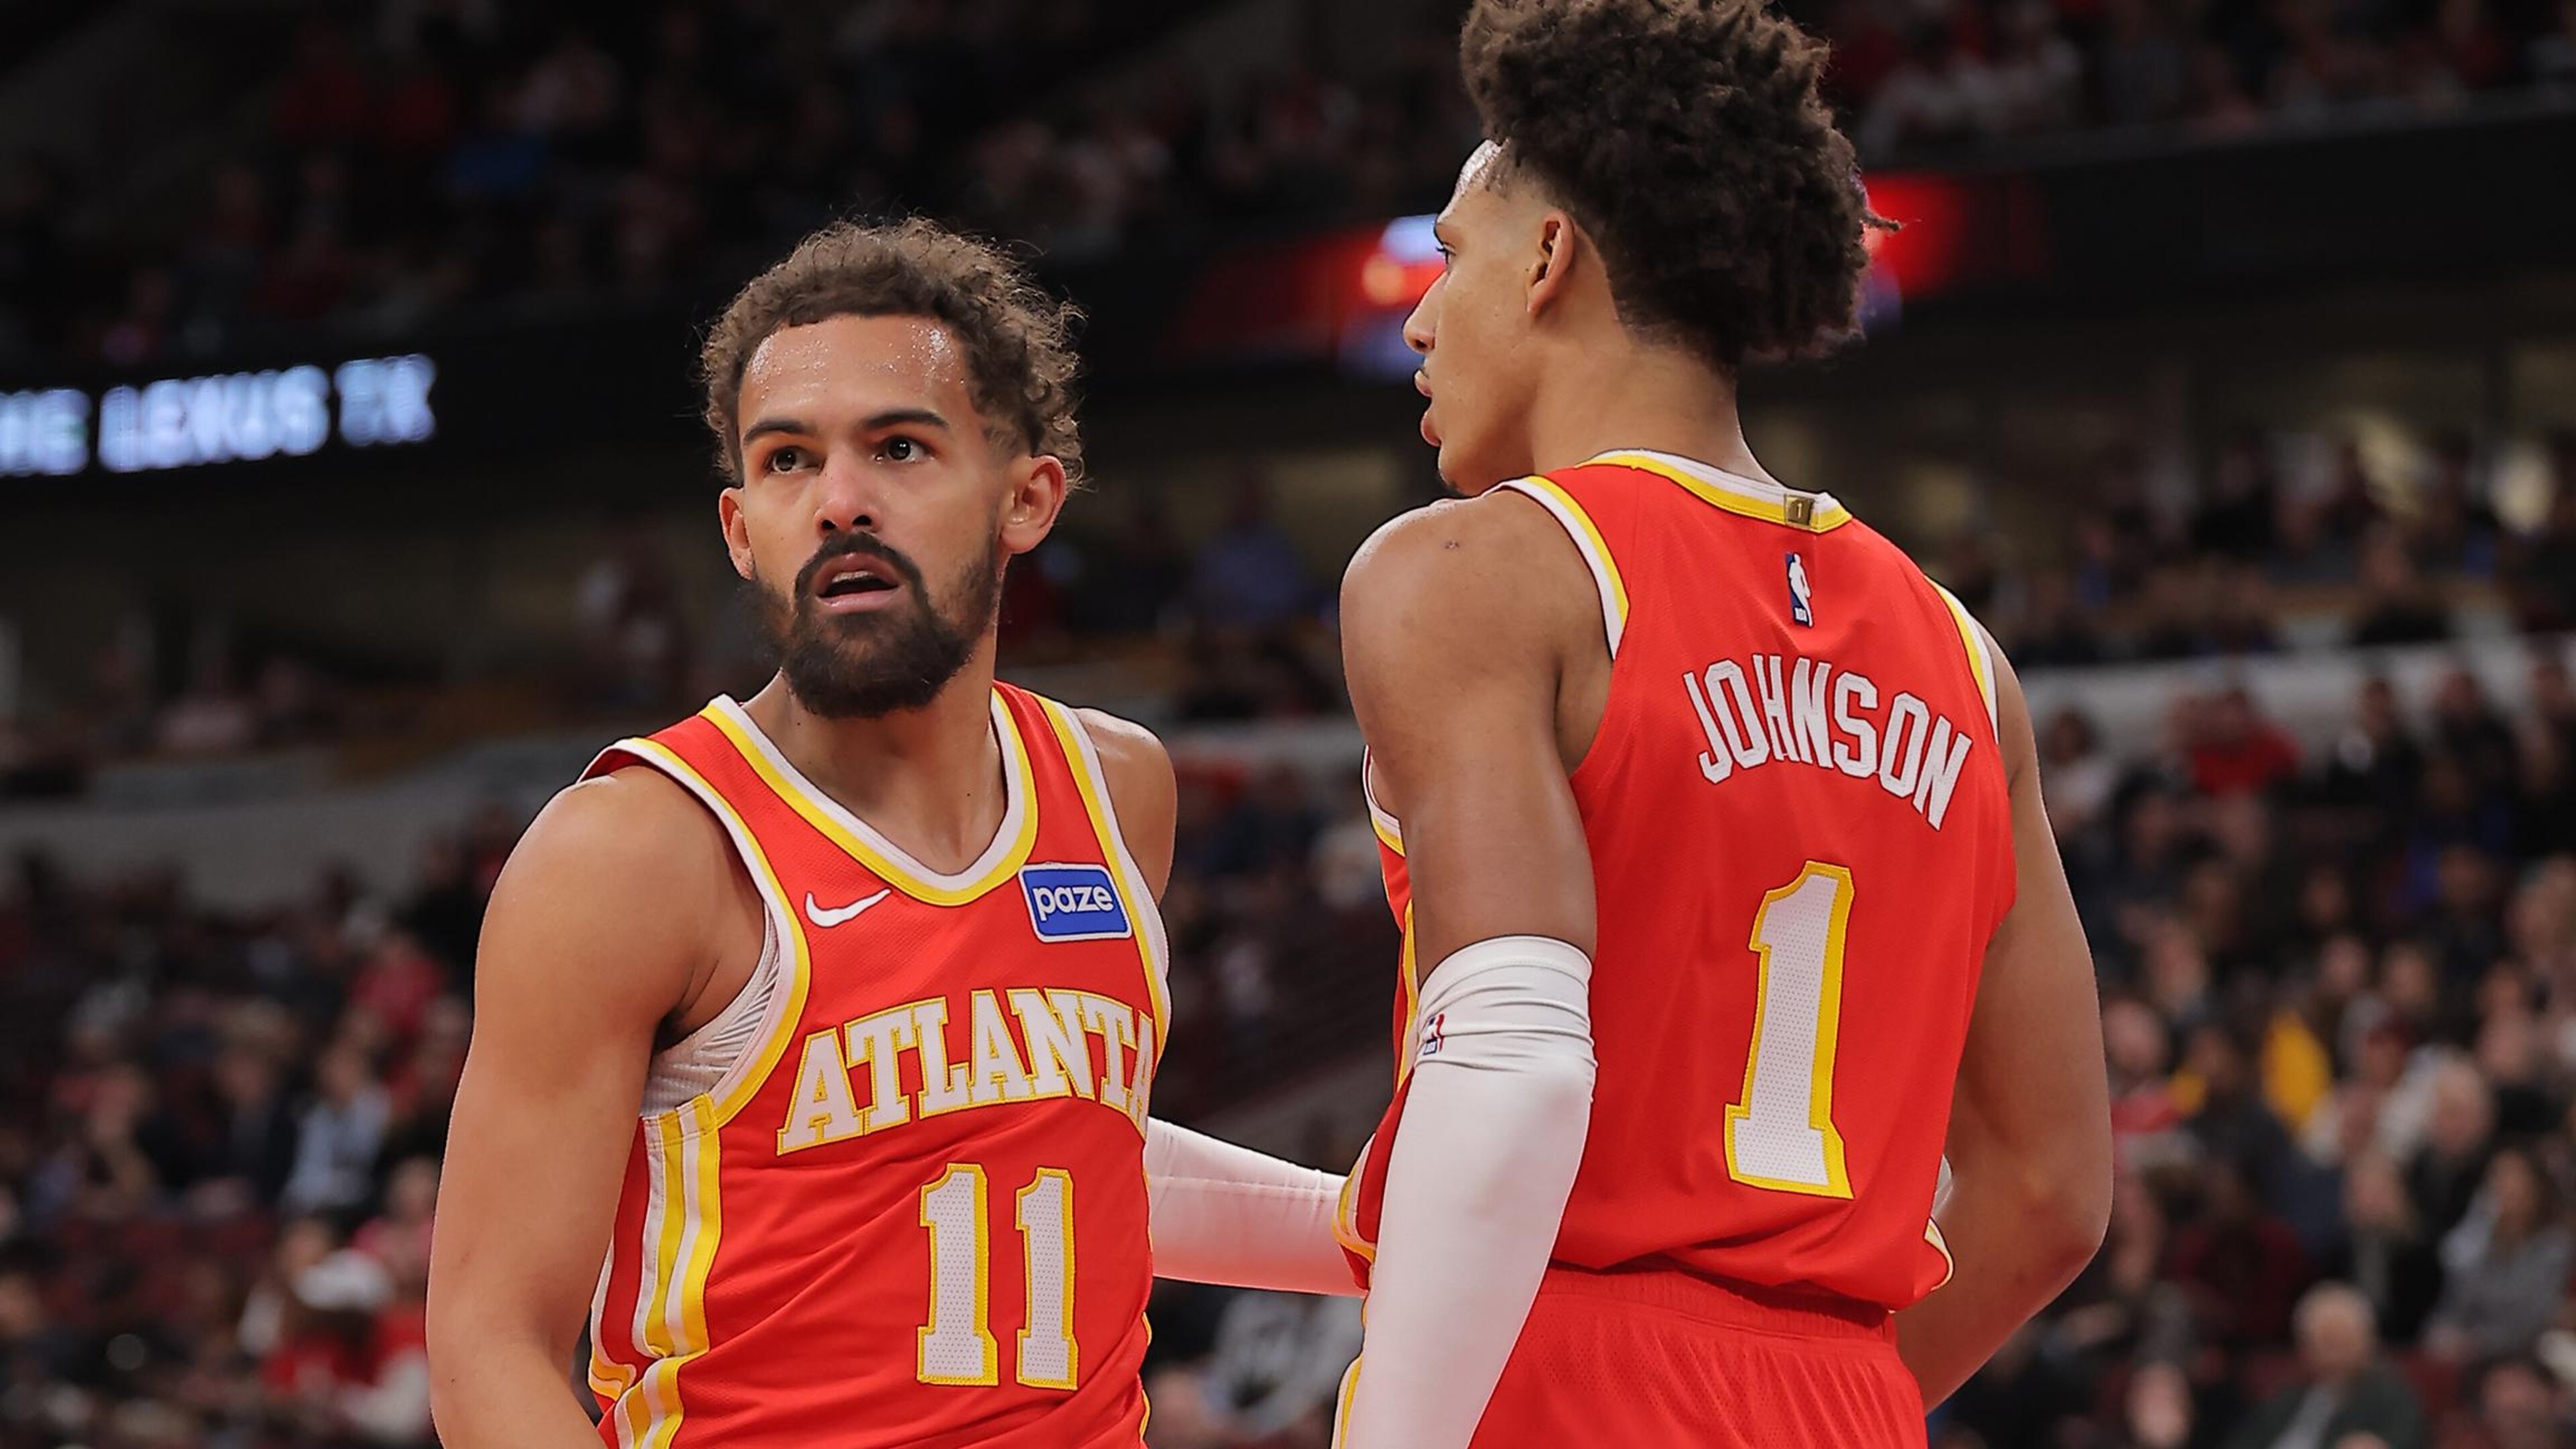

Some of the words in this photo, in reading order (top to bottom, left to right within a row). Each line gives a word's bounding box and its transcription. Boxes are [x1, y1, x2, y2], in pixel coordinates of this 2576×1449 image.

[99, 365, 329, 471] LEXUS
[1682, 654, 1973, 831] JOHNSON
[1032, 885, 1114, 922] paze
[777, 988, 1152, 1155] ATLANTA
[1724, 860, 1855, 1199] 1
[916, 1163, 1079, 1391] 11
